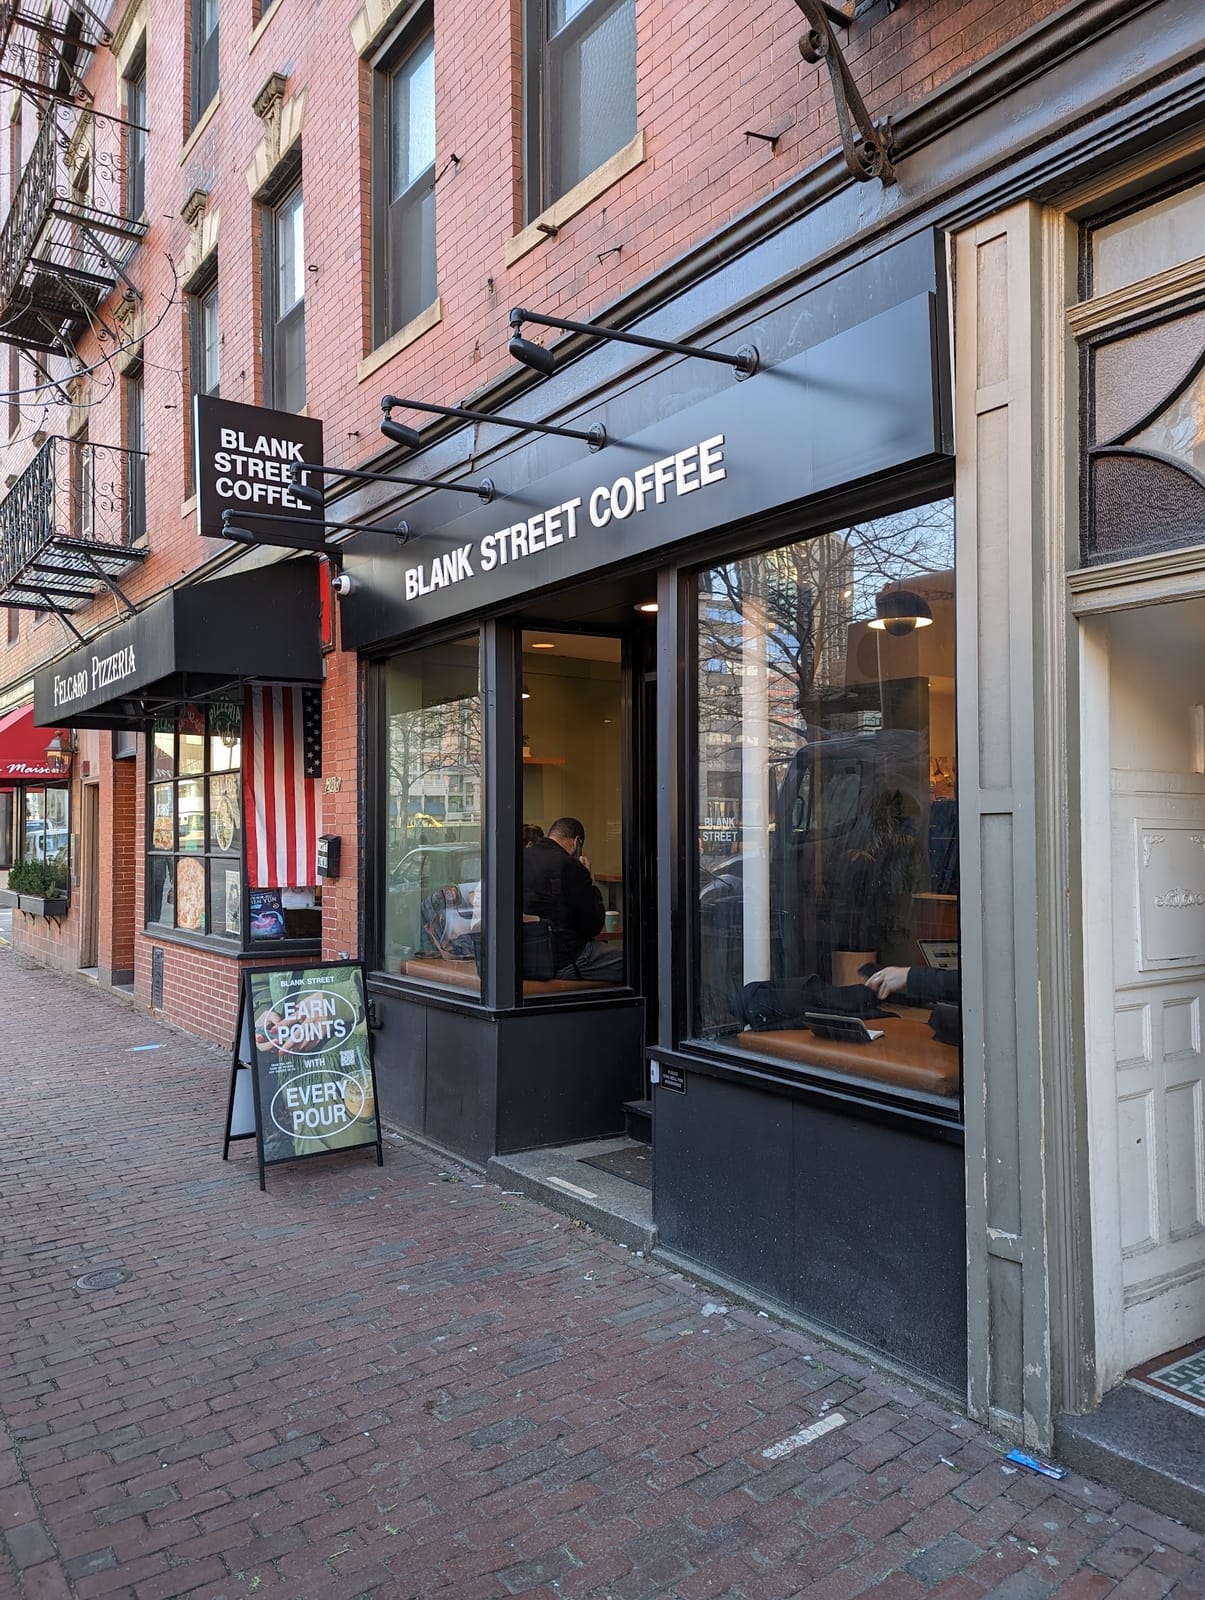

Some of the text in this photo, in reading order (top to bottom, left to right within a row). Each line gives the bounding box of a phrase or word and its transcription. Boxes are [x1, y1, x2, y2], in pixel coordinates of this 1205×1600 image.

[220, 428, 304, 463] BLANK
[404, 434, 726, 600] BLANK STREET COFFEE
[92, 644, 136, 691] PIZZERIA
[702, 817, 738, 842] BLANK STREET
[280, 976, 335, 987] BLANK STREET
[284, 998, 336, 1021] EARN
[278, 1018, 346, 1045] POINTS
[304, 1058, 325, 1069] WITH
[286, 1080, 348, 1108] EVERY
[293, 1103, 347, 1131] POUR
